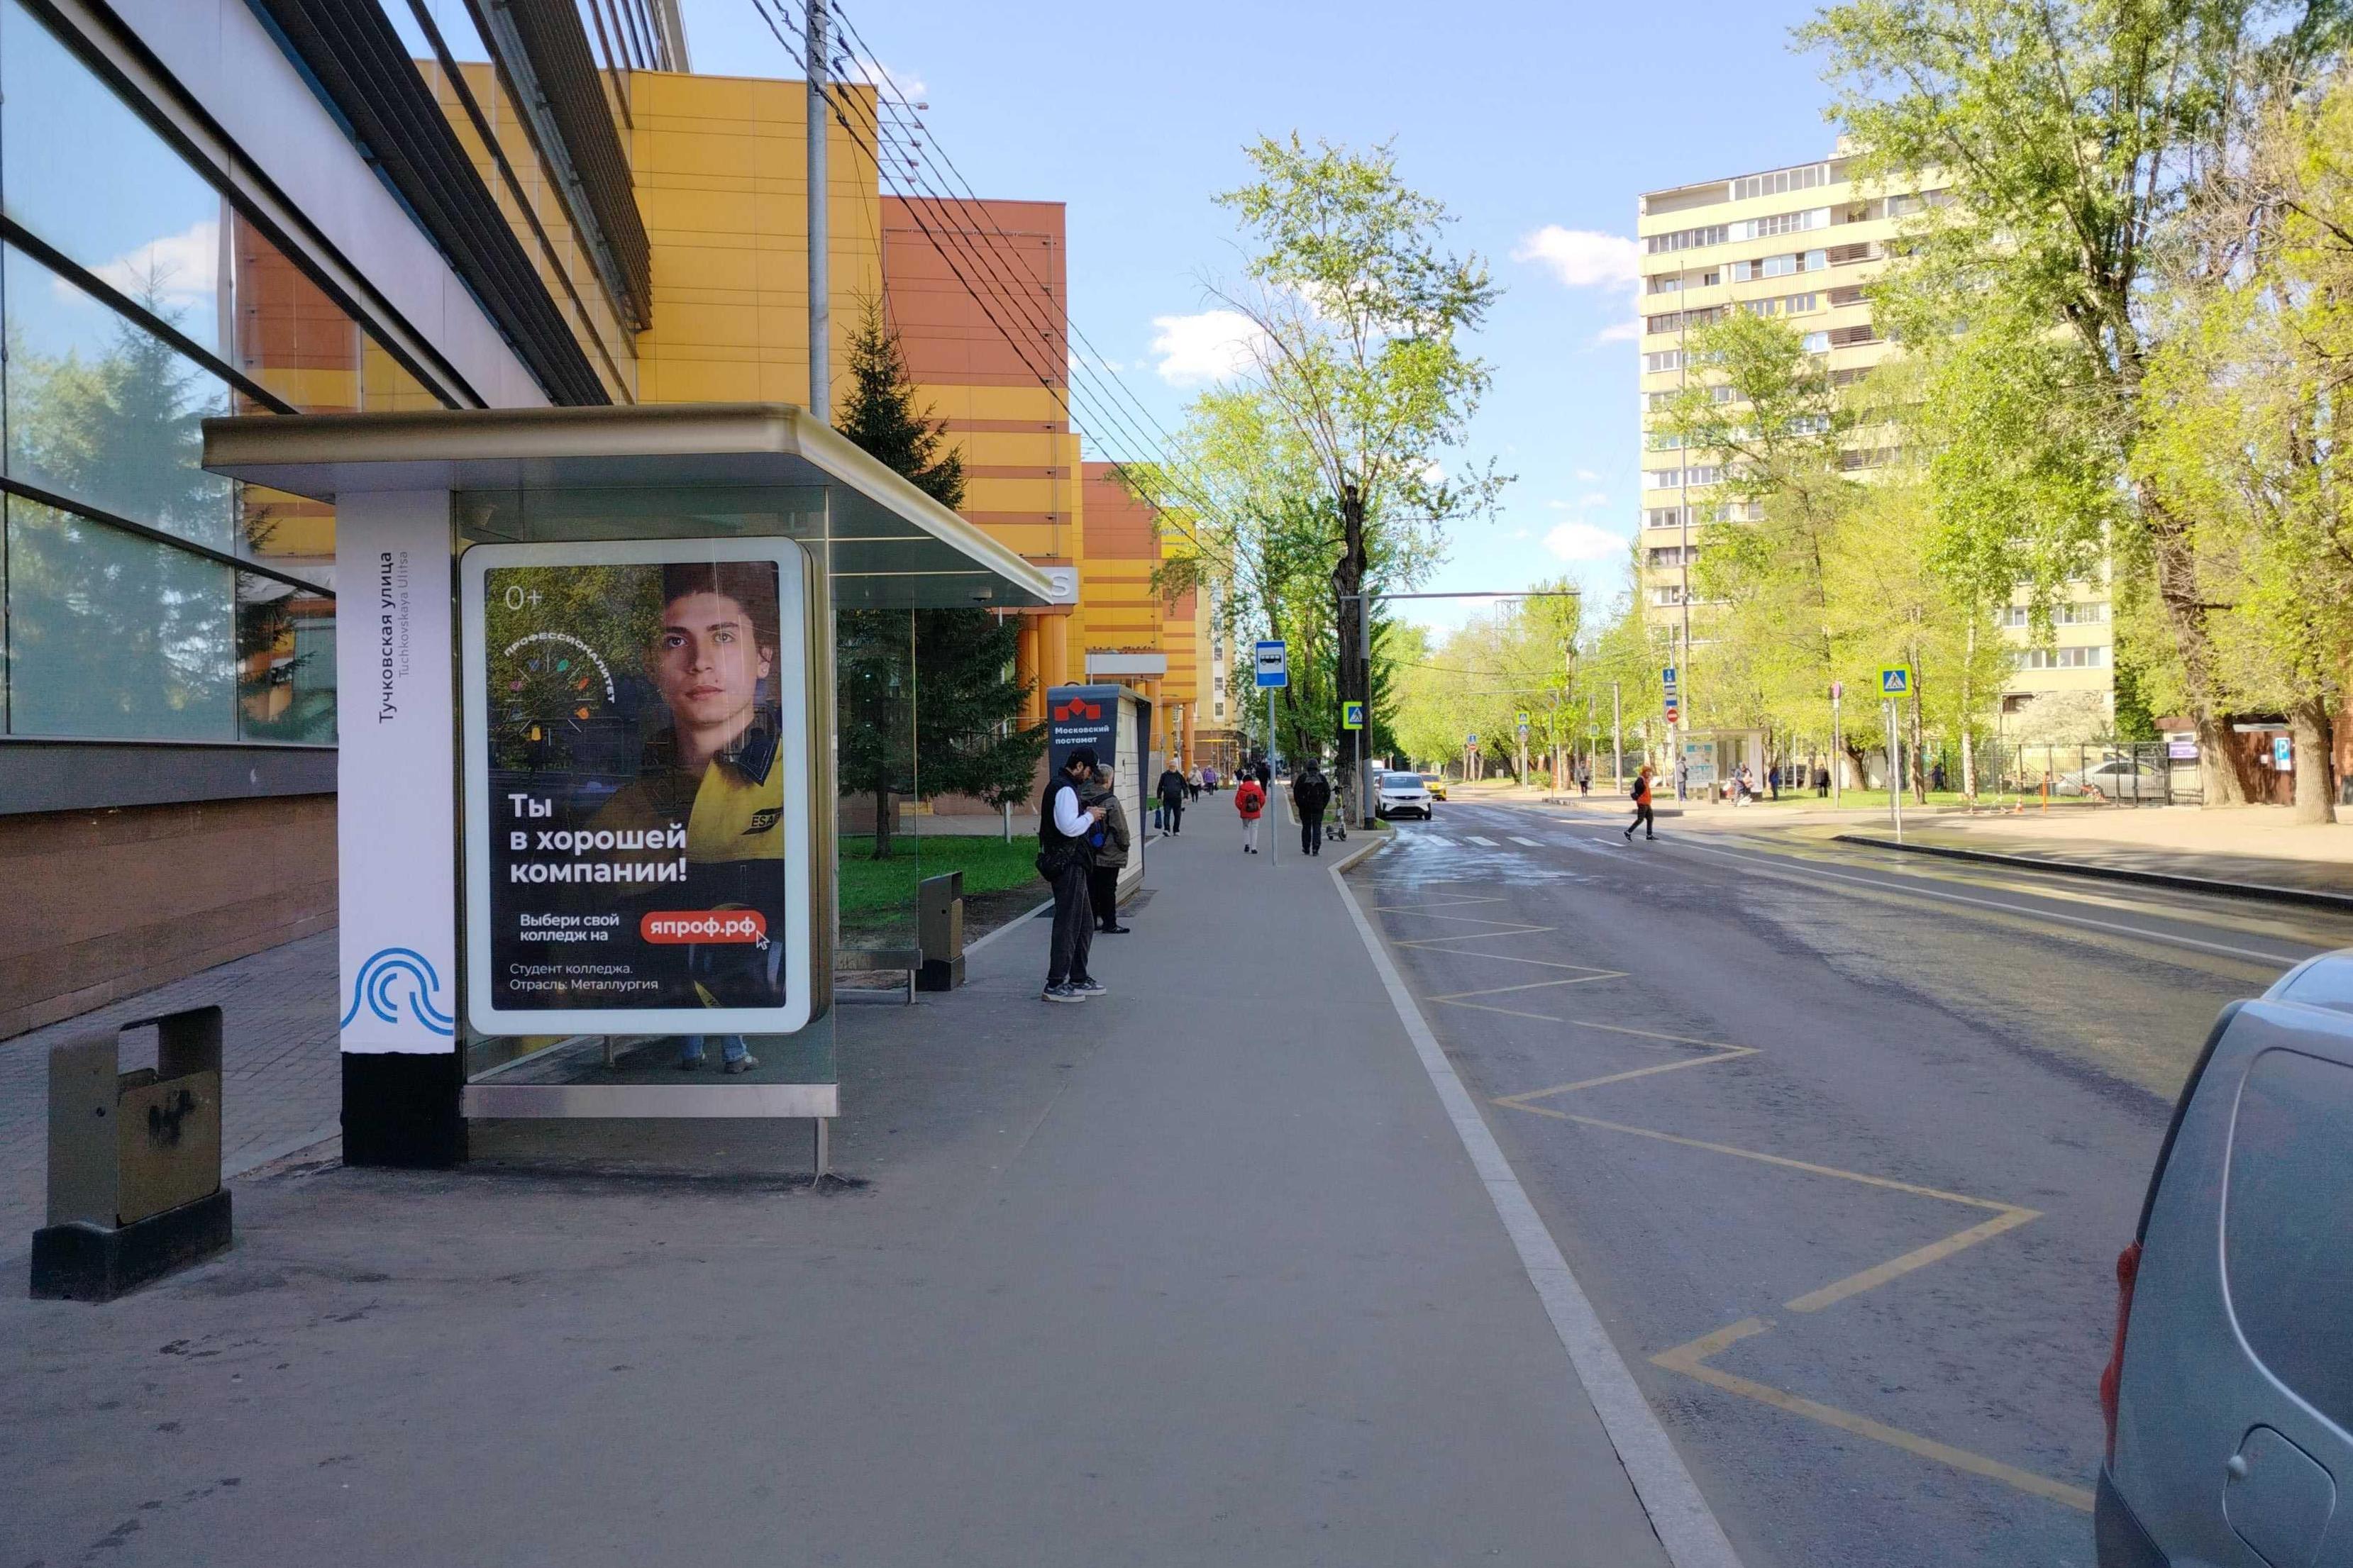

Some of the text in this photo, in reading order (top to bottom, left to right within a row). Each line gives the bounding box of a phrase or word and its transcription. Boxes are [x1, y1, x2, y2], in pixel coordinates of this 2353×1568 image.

[504, 584, 543, 611] 0+
[397, 550, 411, 679] Tuchkovskaya Ulitsa
[380, 551, 397, 724] Тучковская улица
[504, 633, 616, 704] ПРОФЕССИОНАЛИТЕТ
[1055, 725, 1109, 735] Московский
[508, 794, 552, 818] Ты
[510, 823, 687, 856] в хорошей
[511, 857, 687, 883] компании!
[520, 912, 619, 928] Выбери свой
[650, 916, 756, 937] япроф.рф
[520, 930, 609, 943] колледж на
[509, 963, 633, 977] Студент колледжа.
[509, 978, 659, 992] Отрасль: Металлургия
